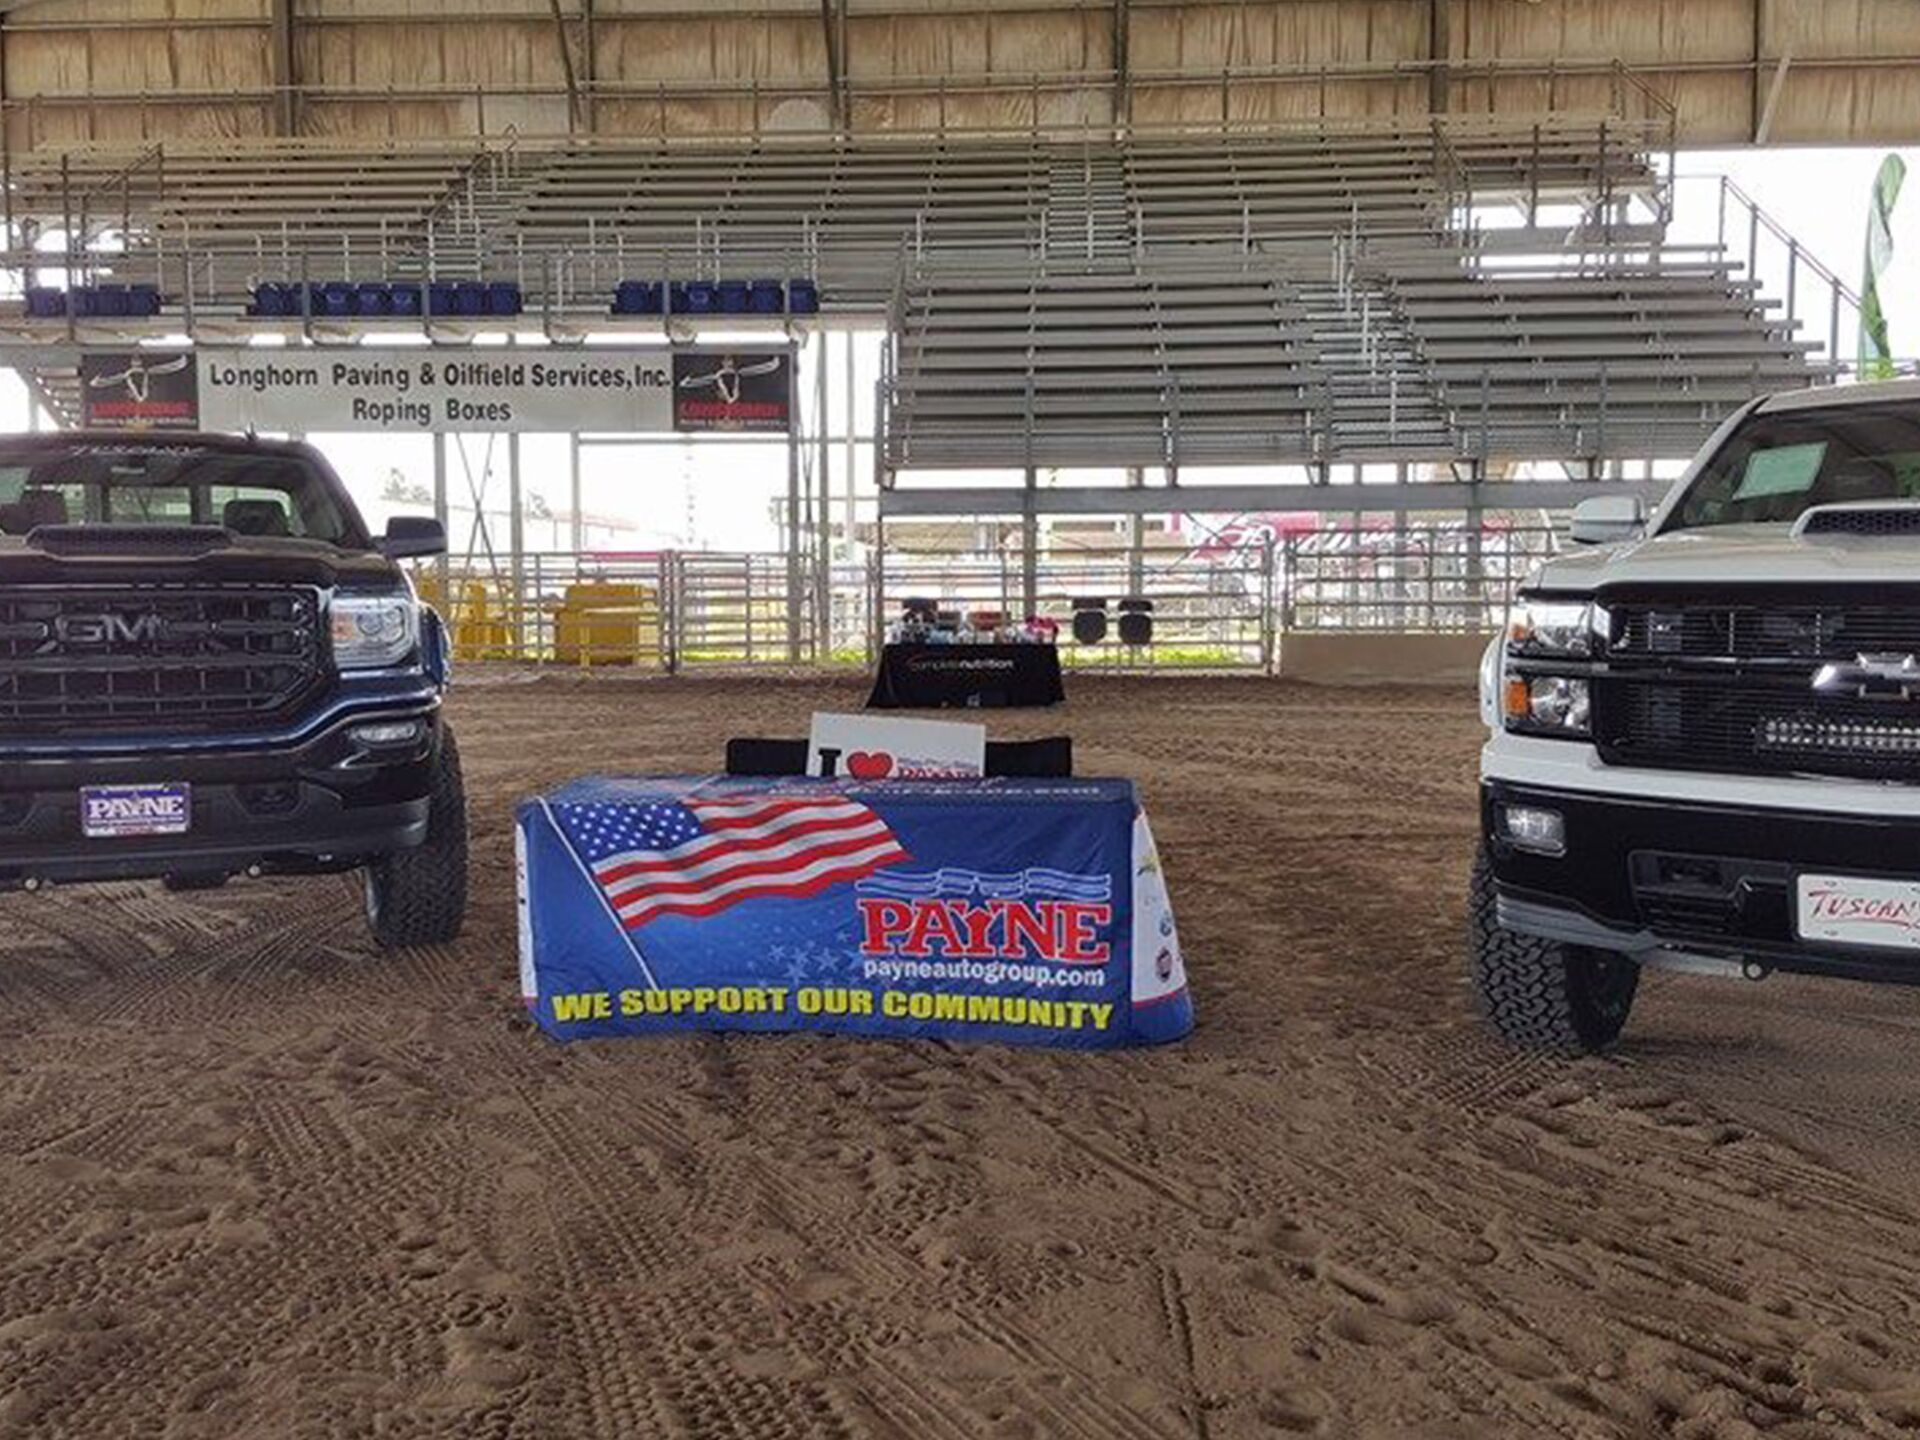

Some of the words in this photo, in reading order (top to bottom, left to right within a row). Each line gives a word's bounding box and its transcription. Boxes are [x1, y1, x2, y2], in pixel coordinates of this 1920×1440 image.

[210, 363, 318, 391] Longhorn
[333, 363, 410, 392] Paving
[419, 363, 436, 387] &
[444, 363, 525, 387] Oilfield
[353, 399, 431, 425] Roping
[446, 399, 512, 422] Boxes
[818, 748, 842, 777] I
[87, 796, 184, 818] PAYNE
[857, 898, 1112, 965] PAYNE
[864, 958, 1106, 988] payneautogroup.com
[552, 992, 613, 1022] WE
[620, 987, 789, 1016] SUPPORT
[796, 988, 875, 1014] OUR
[882, 991, 1114, 1031] COMMUNITY
